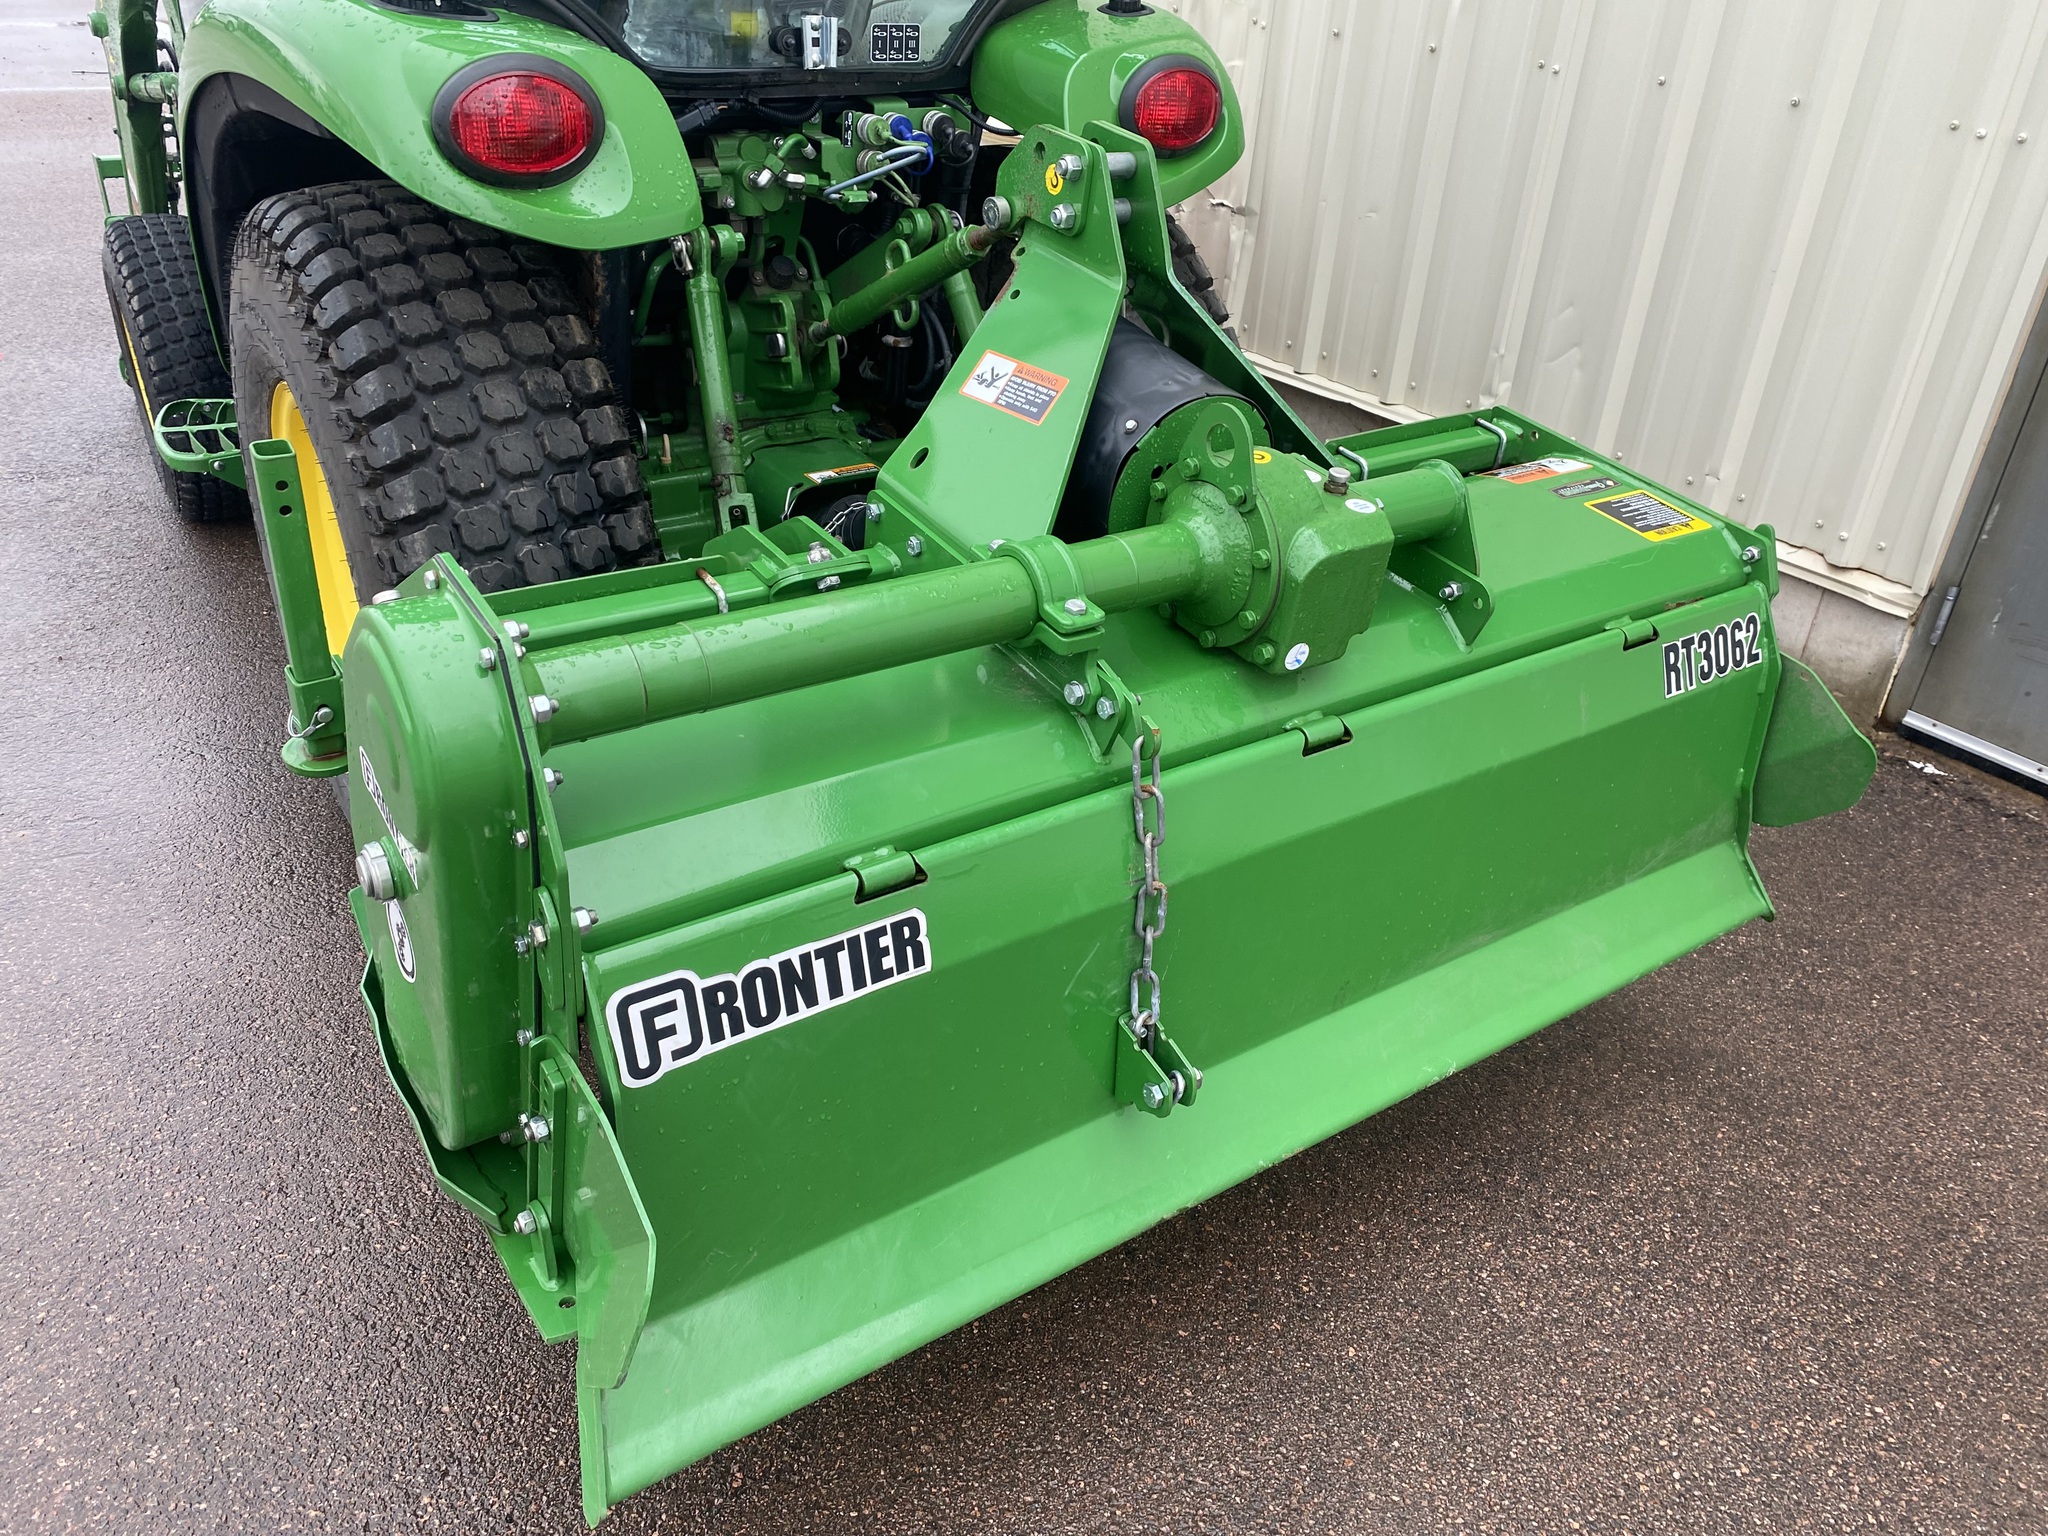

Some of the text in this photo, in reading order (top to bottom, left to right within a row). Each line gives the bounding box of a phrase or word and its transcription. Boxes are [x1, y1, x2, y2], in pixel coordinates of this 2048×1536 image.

[1024, 368, 1058, 387] WARNING
[1663, 613, 1760, 696] RT3062
[615, 915, 926, 1081] FRONTIER
